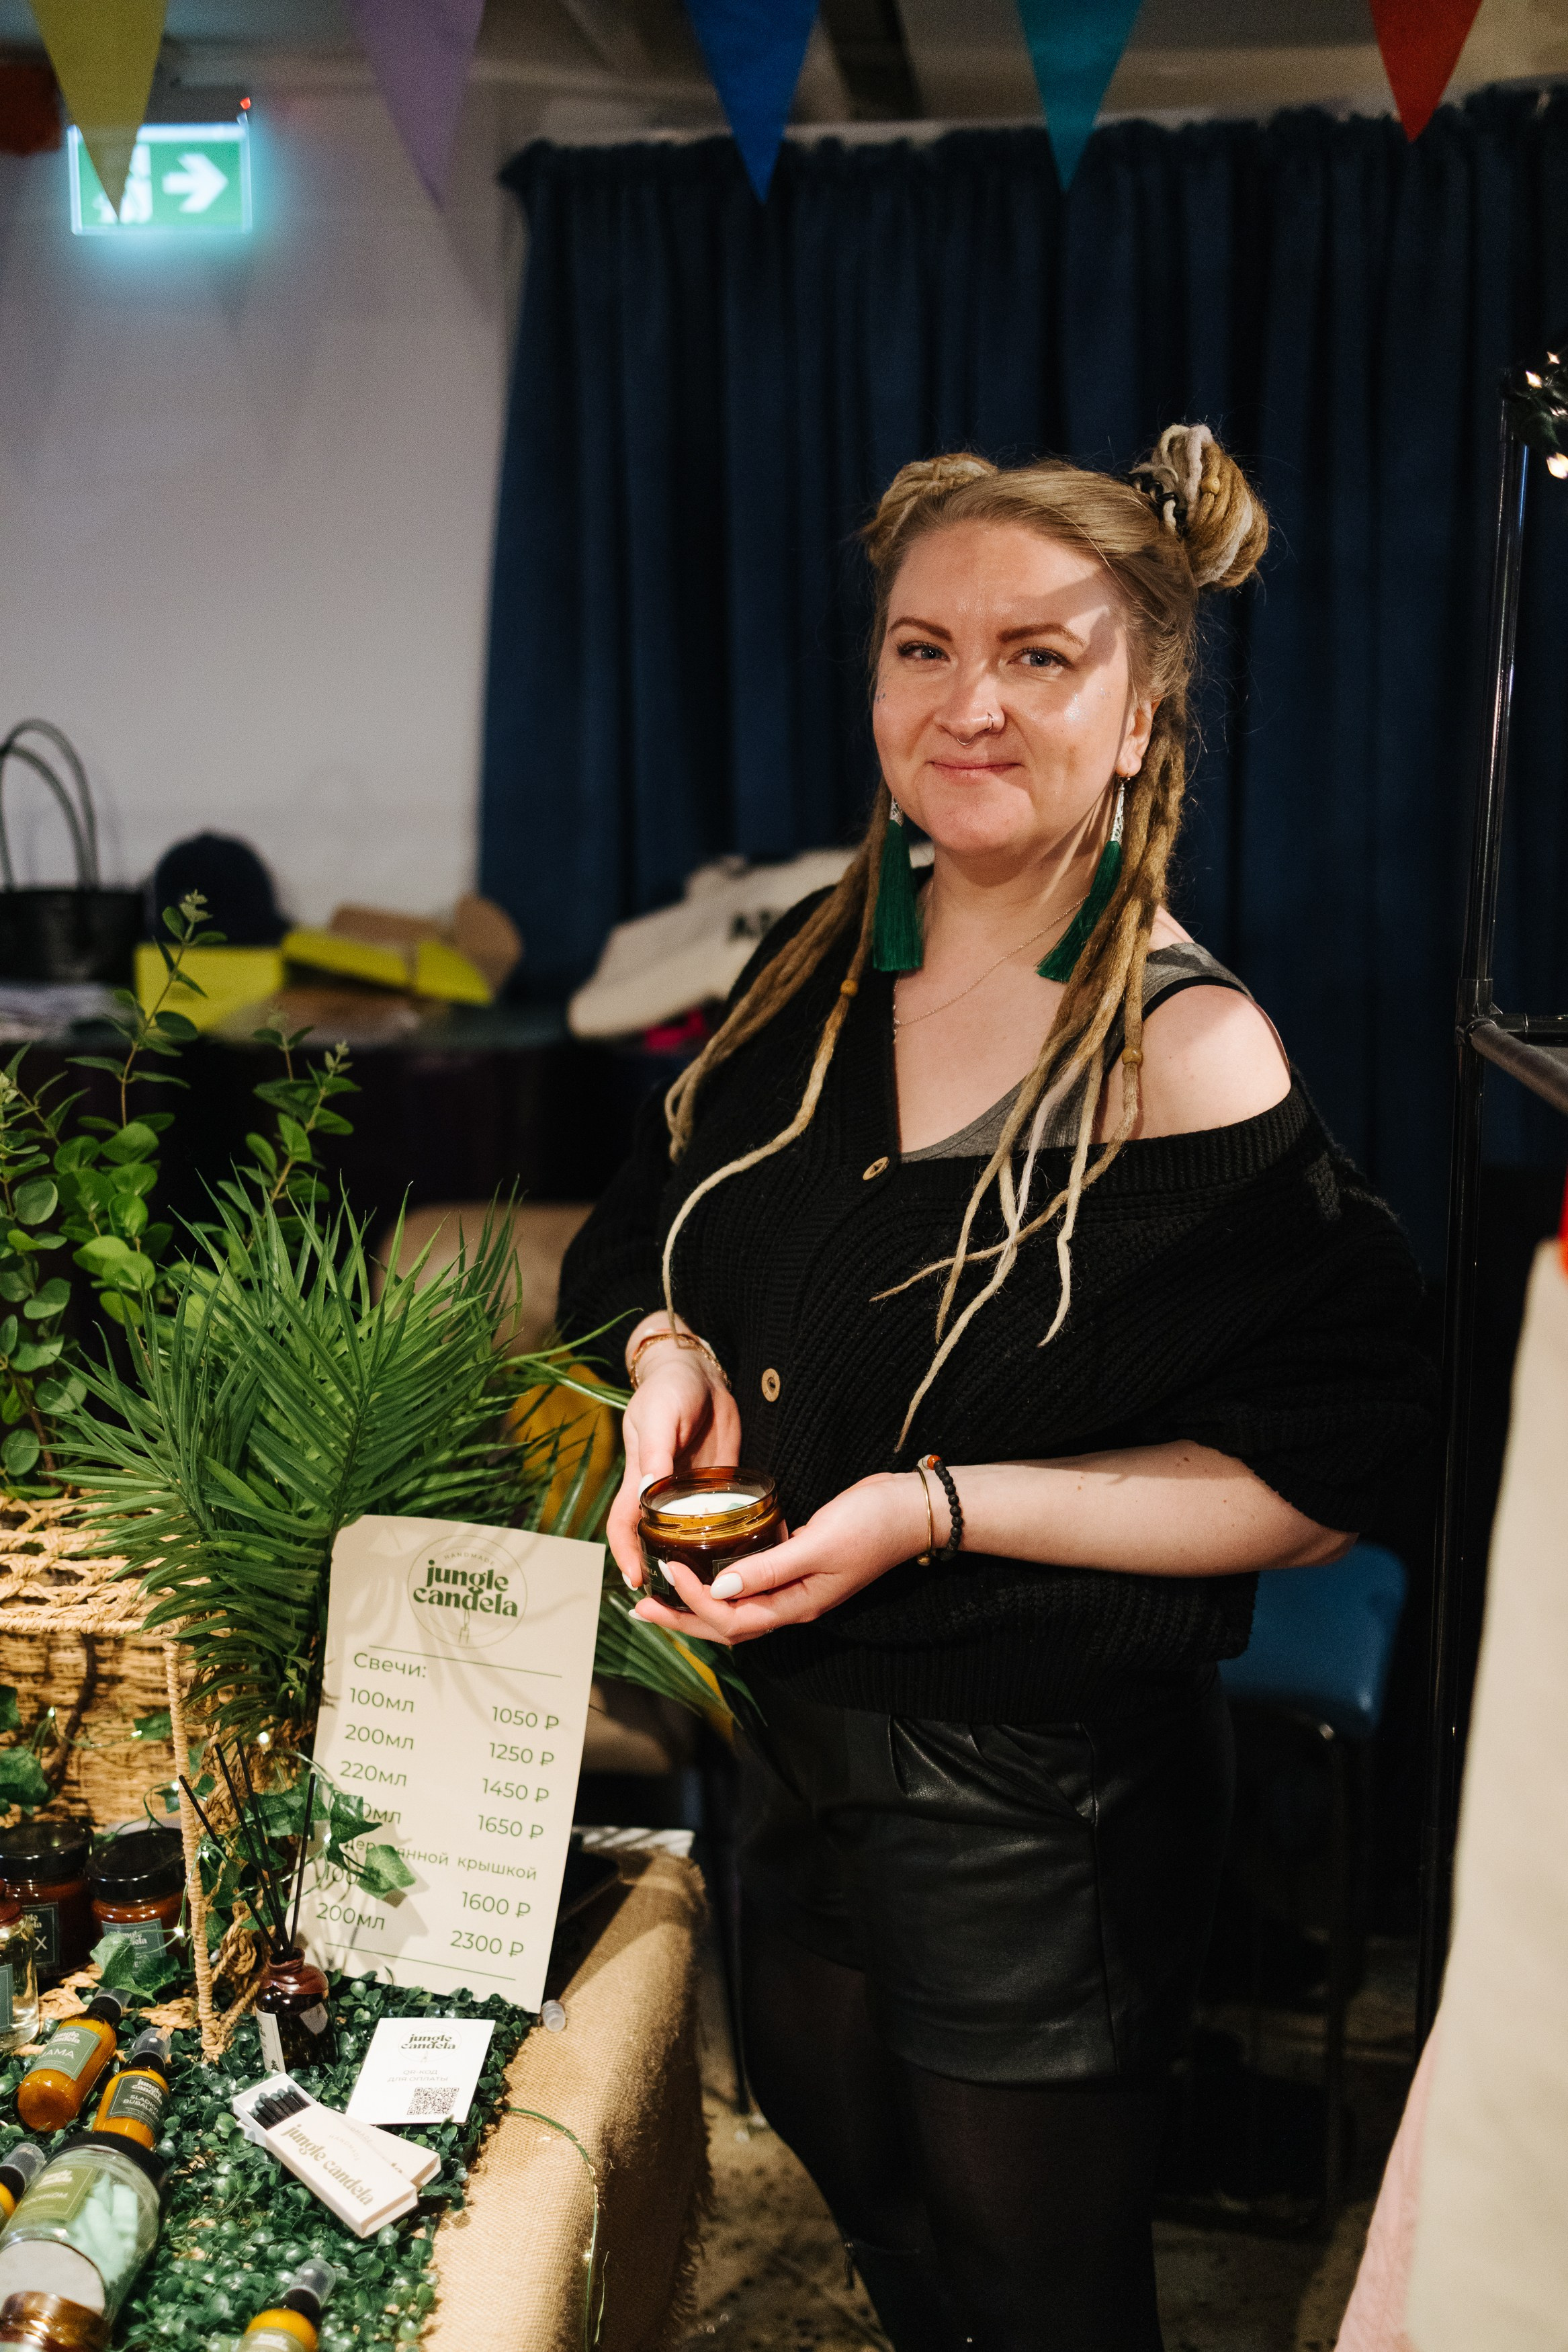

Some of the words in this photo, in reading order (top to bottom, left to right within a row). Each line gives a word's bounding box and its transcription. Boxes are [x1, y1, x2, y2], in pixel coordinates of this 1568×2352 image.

[444, 1552, 494, 1566] HANDMADE
[425, 1559, 509, 1595] jungle
[413, 1587, 518, 1618] candela
[353, 1652, 427, 1678] Свечи:
[349, 1687, 415, 1713] 100мл
[492, 1706, 538, 1728] 1050
[344, 1724, 415, 1750] 200мл
[489, 1742, 533, 1764] 1250
[340, 1760, 407, 1788] 220мл
[482, 1777, 528, 1800] 1450
[478, 1814, 523, 1837] 1650
[458, 1852, 537, 1881] крышкой
[462, 1891, 509, 1915] 1600
[316, 1902, 386, 1931] 200мл
[450, 1930, 503, 1954] 2300
[408, 2033, 453, 2044] jungle
[280, 2124, 326, 2162] jungle
[322, 2159, 374, 2206] candela
